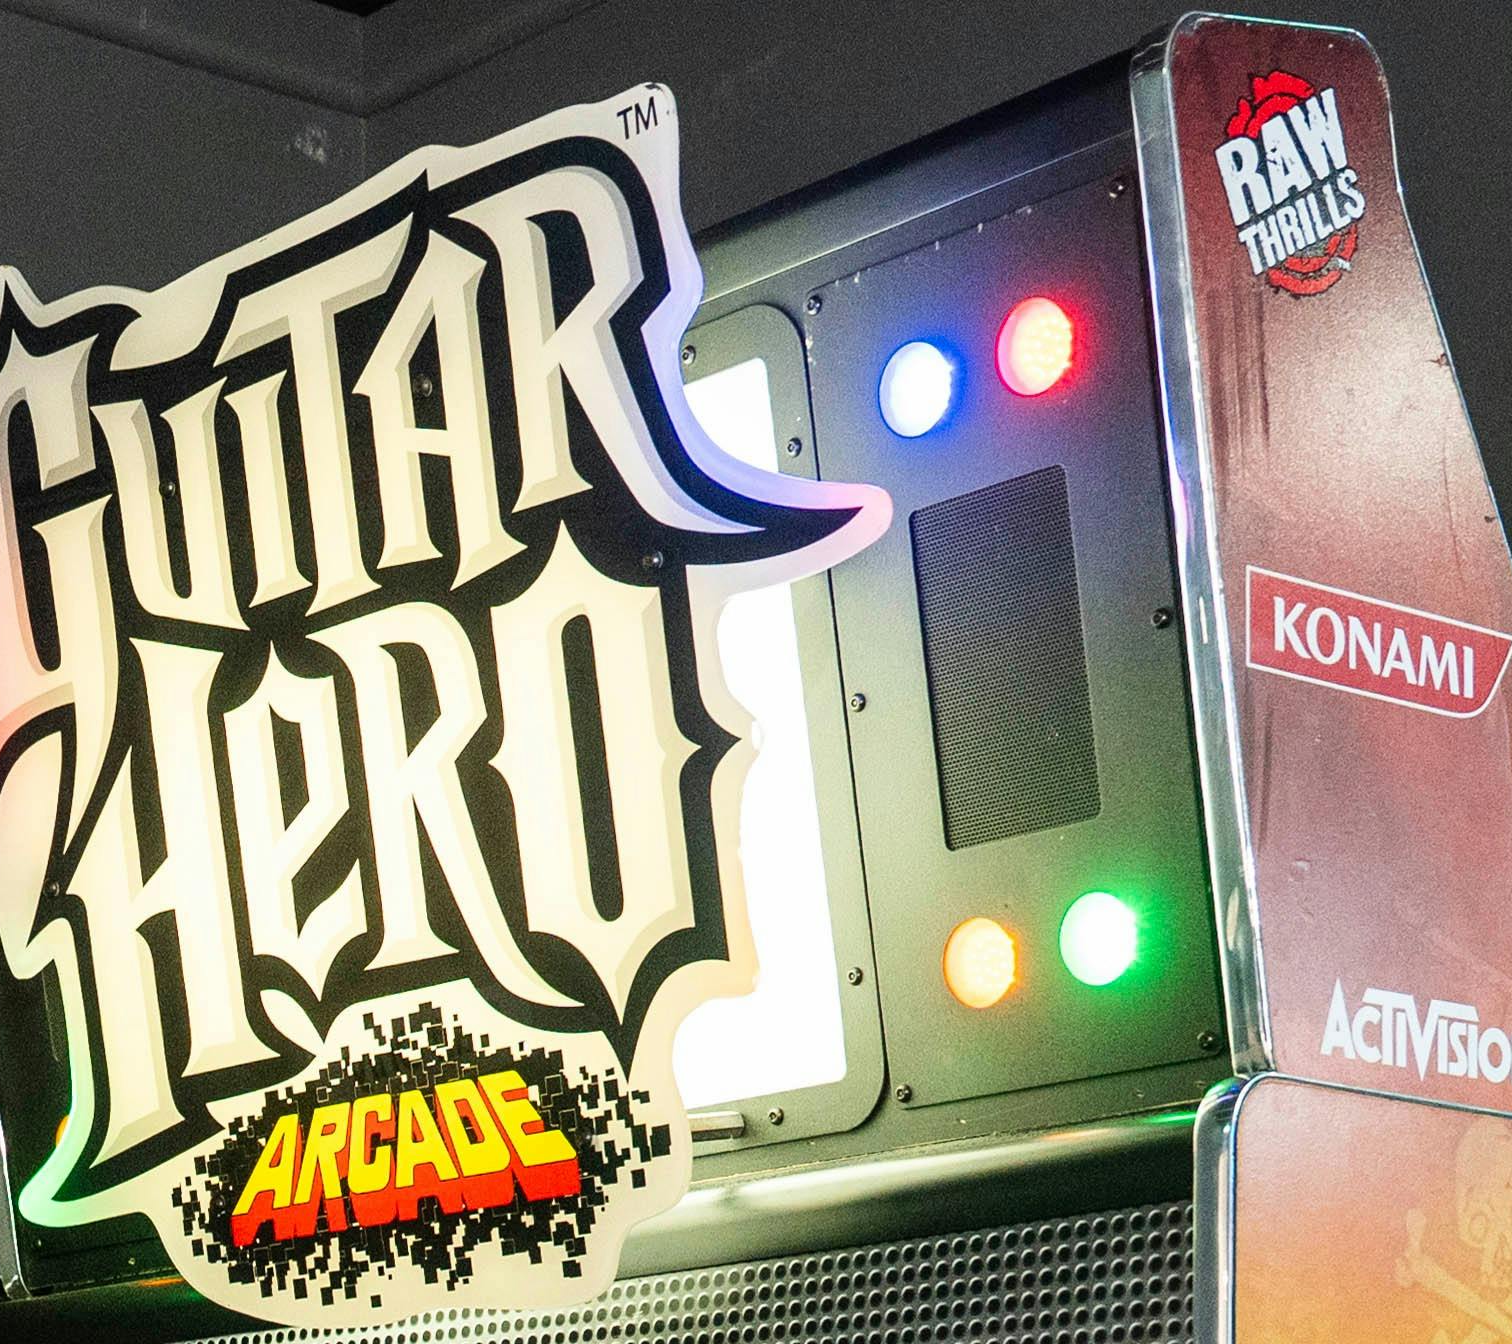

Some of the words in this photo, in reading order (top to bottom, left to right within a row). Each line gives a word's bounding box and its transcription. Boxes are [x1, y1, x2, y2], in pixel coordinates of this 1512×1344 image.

[1214, 87, 1349, 227] RAW
[1238, 168, 1366, 275] THRILLS
[1273, 595, 1474, 699] KONAMI
[230, 1071, 583, 1248] ARCADE
